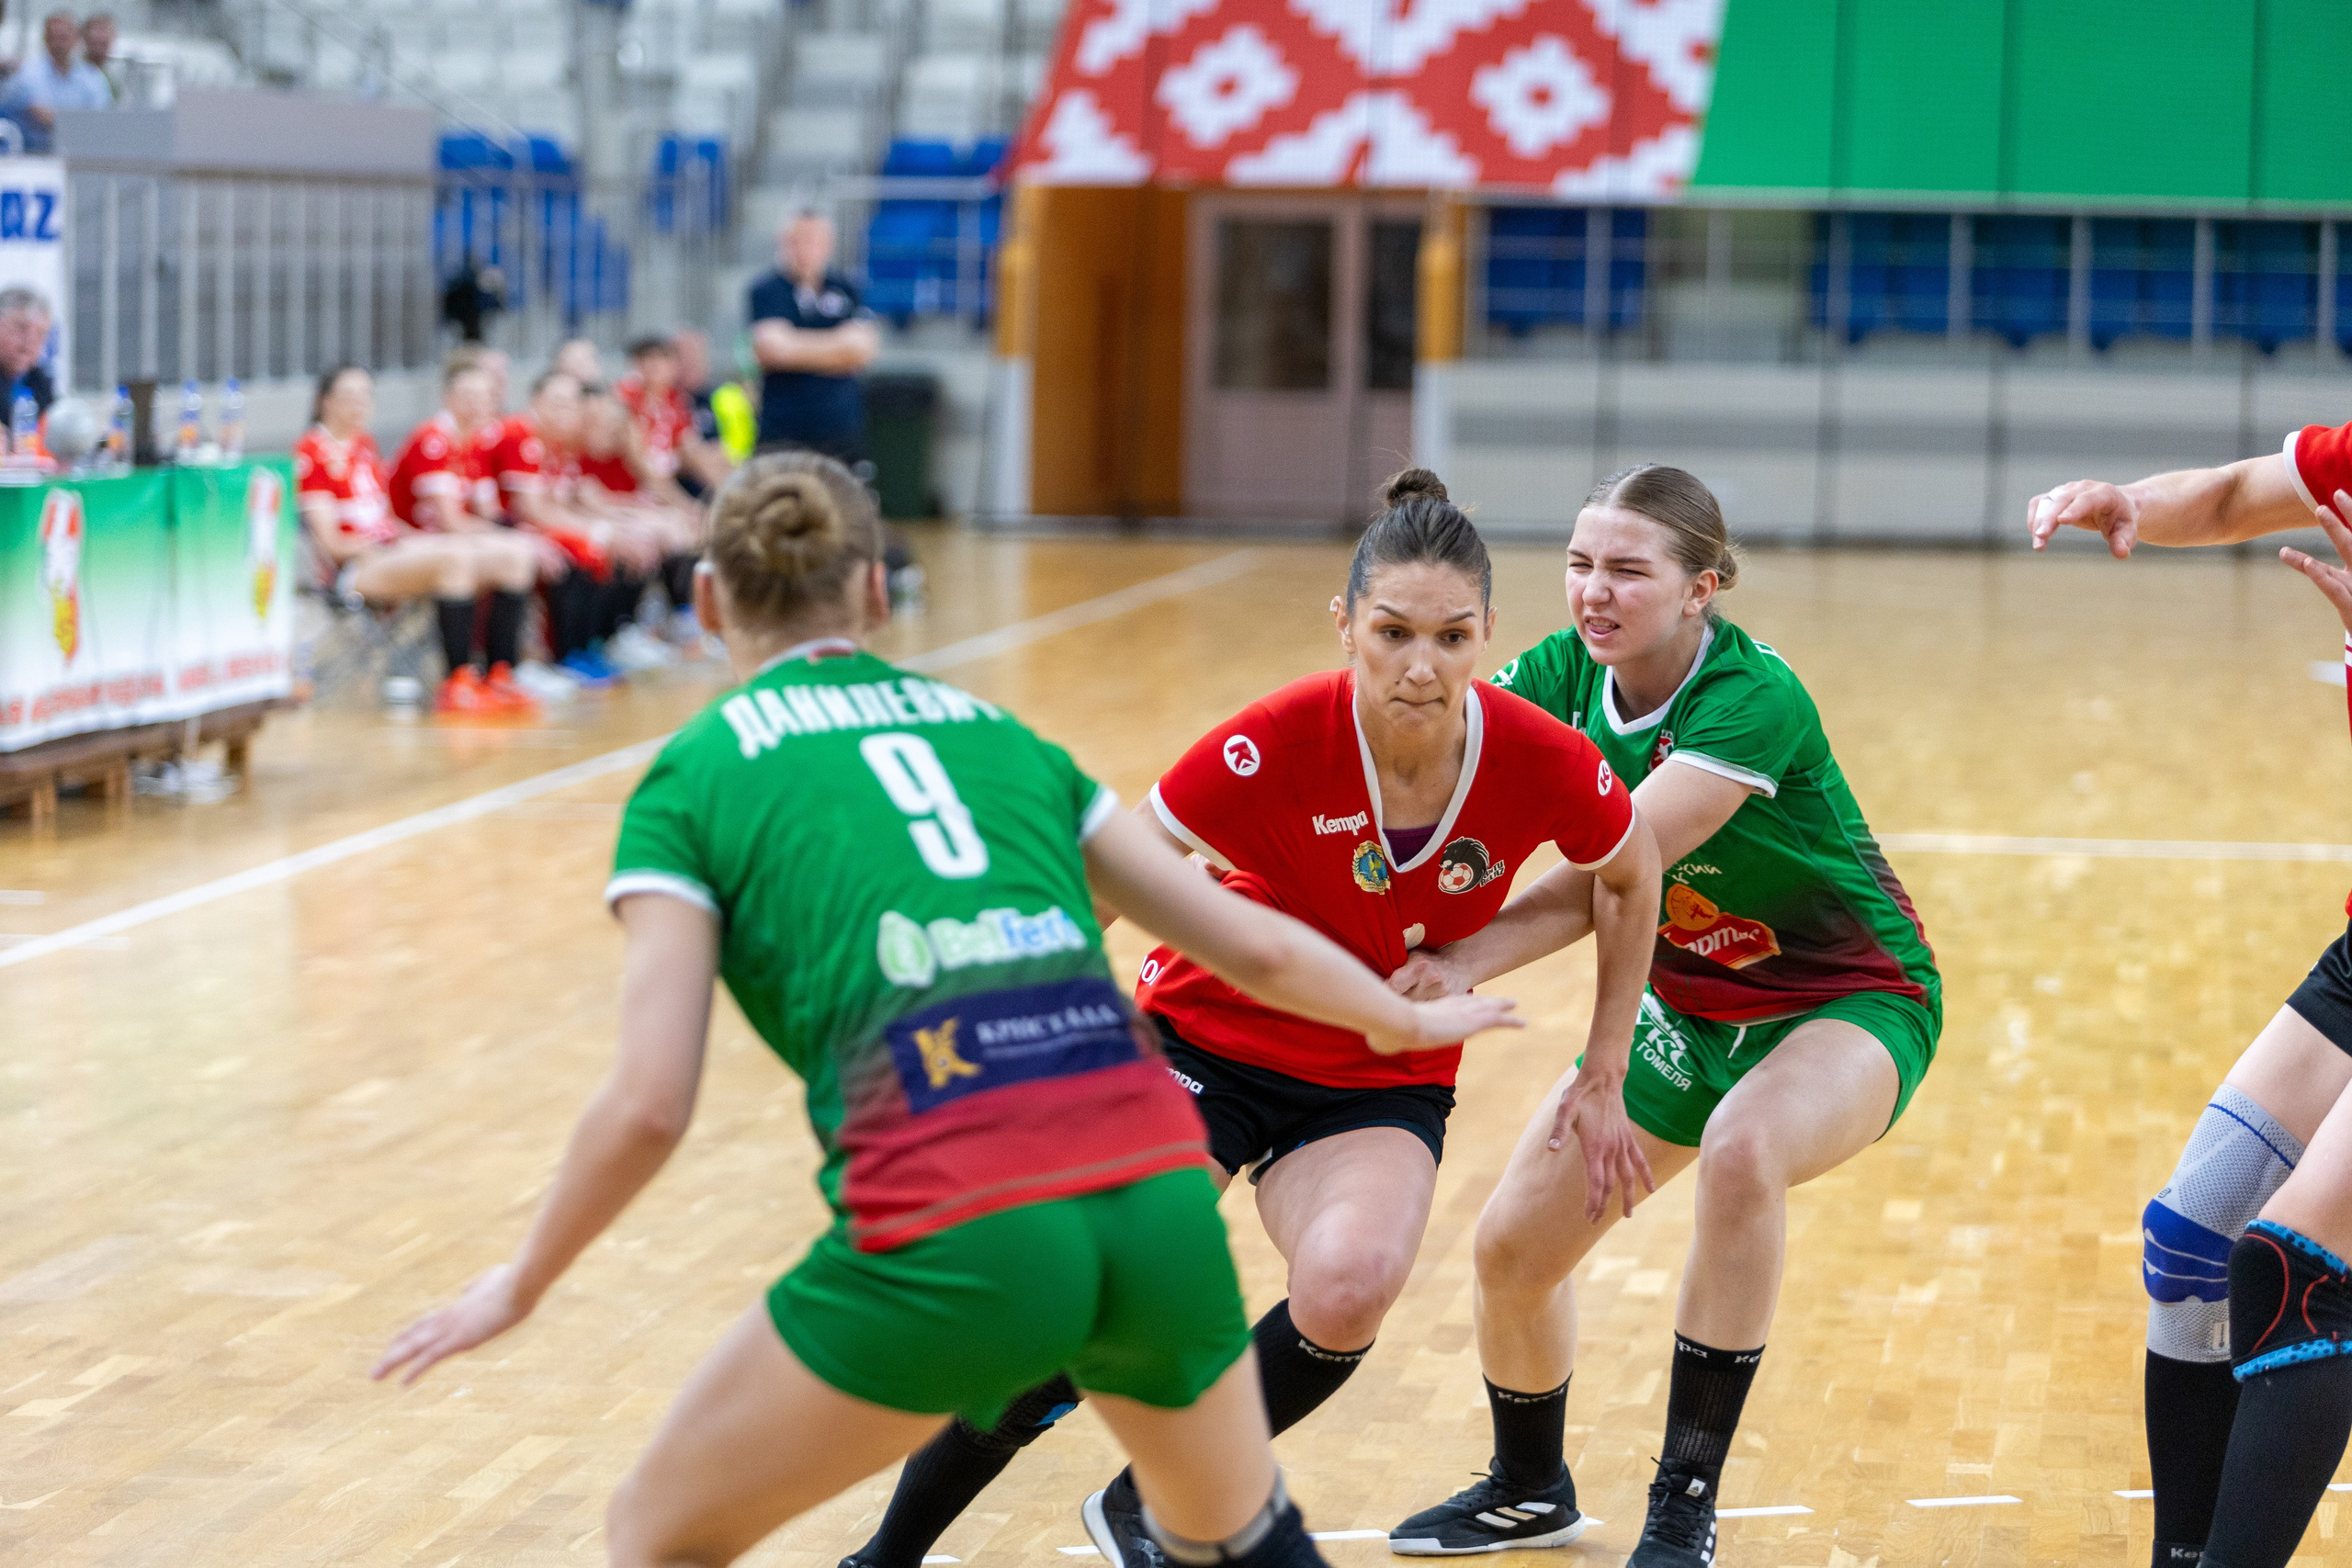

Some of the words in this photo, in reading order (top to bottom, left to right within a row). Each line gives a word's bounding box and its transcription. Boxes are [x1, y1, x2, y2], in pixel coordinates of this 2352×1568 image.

[858, 731, 990, 880] 9
[1312, 810, 1369, 836] Kempa
[1636, 1041, 1692, 1092] ГОМЕЛЯ
[2170, 1547, 2206, 1559] Ke
